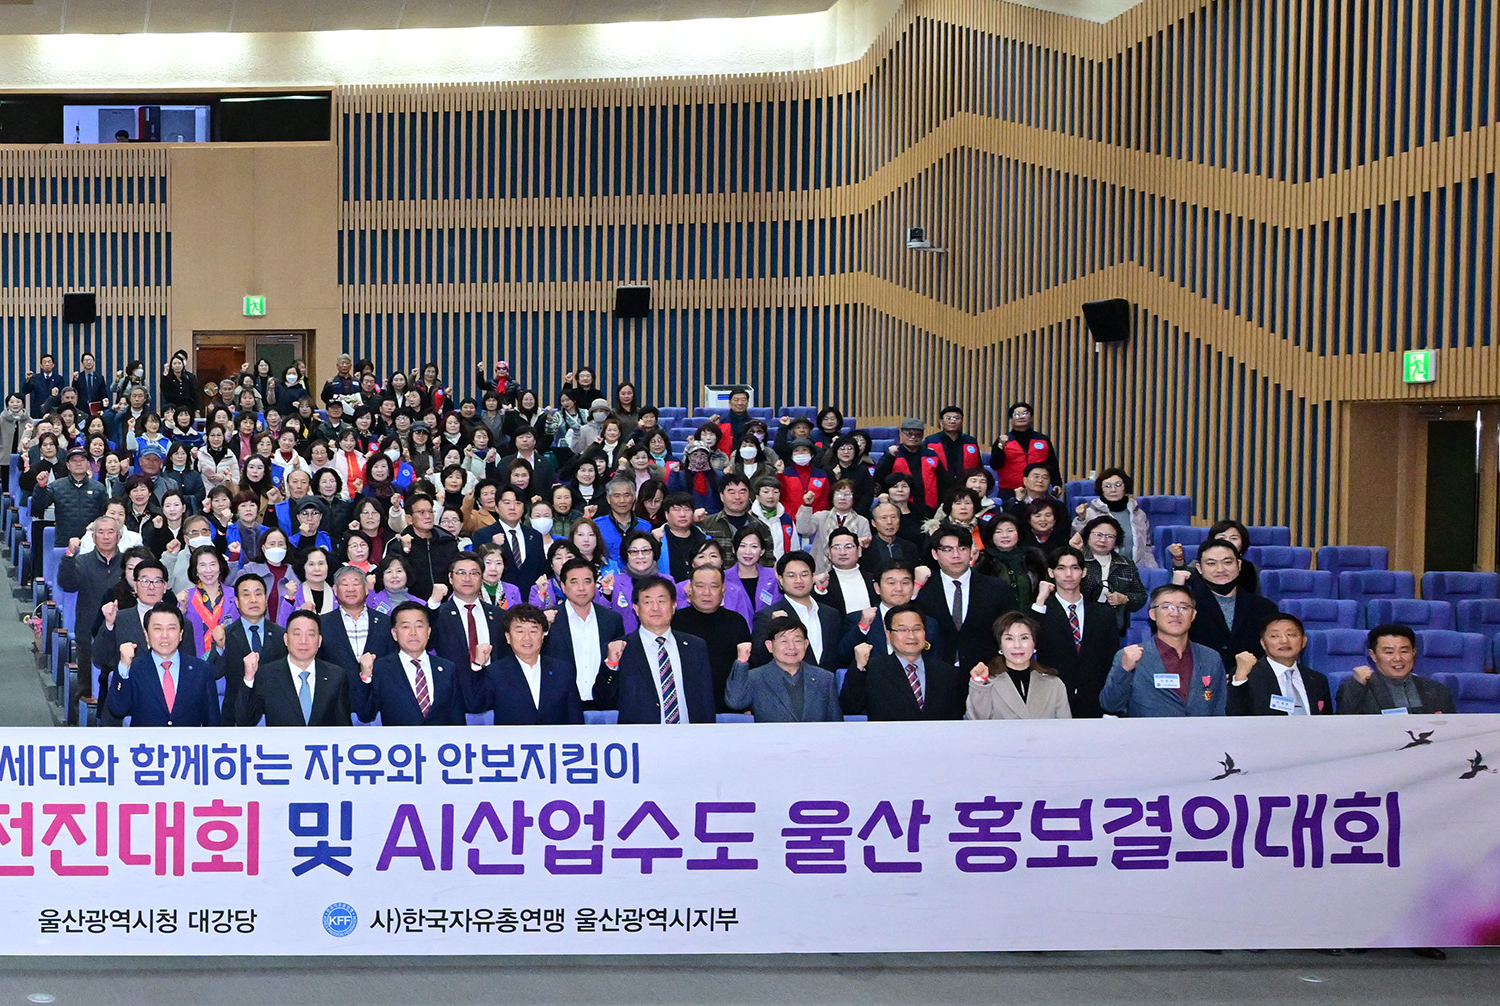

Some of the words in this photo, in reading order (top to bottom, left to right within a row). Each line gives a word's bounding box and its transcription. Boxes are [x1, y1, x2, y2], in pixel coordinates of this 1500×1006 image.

[129, 743, 293, 786] 함께하는
[304, 743, 427, 786] 자유와
[437, 743, 640, 785] 안보지킴이
[288, 800, 354, 877] 및
[375, 799, 759, 876] AI산업수도
[780, 799, 932, 875] 울산
[948, 790, 1402, 874] 홍보결의대회
[37, 908, 178, 934] 울산광역시청
[188, 908, 258, 934] 대강당
[329, 916, 351, 926] KFF
[369, 907, 565, 935] 사)한국자유총연맹
[574, 907, 739, 933] 울산광역시지부
